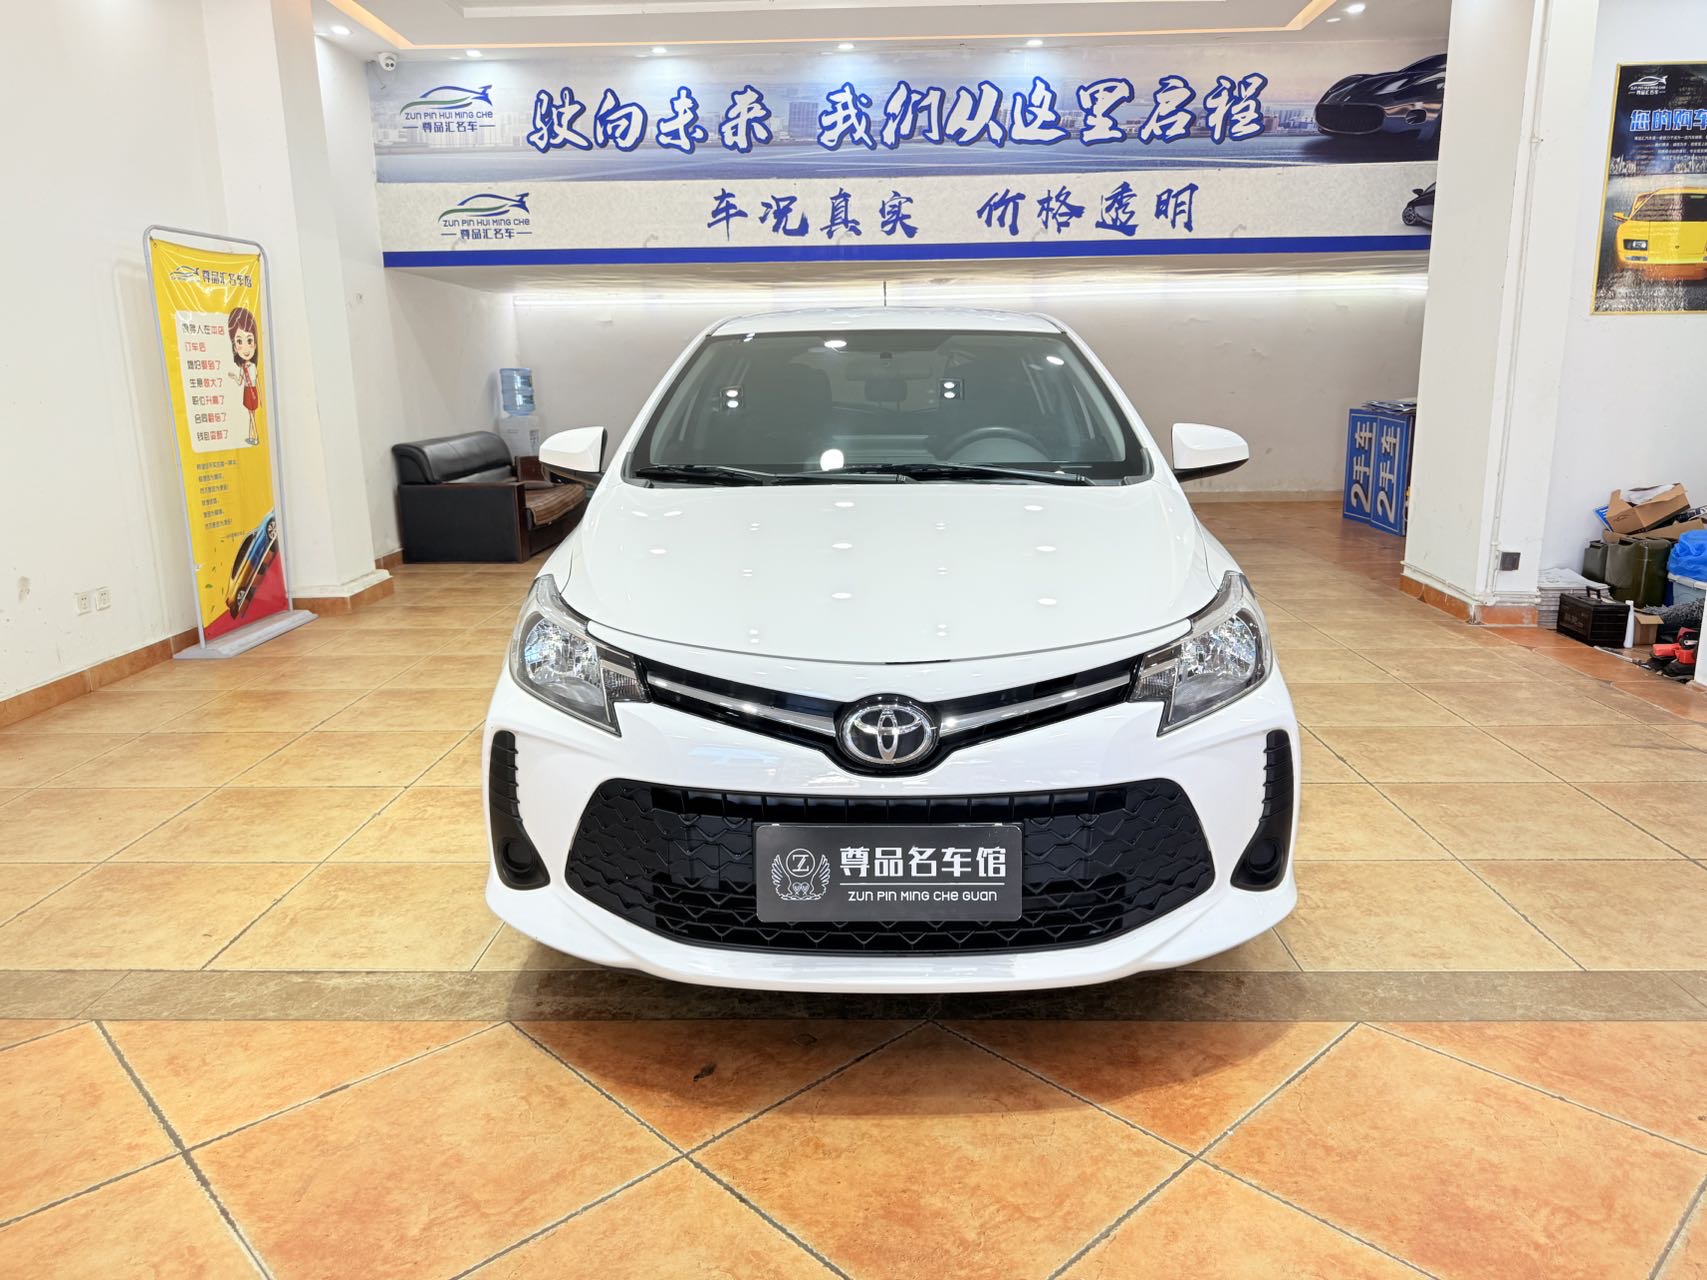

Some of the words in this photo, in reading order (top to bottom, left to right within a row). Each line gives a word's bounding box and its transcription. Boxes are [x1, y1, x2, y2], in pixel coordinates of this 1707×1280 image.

[528, 84, 772, 153] 驶向未来
[817, 72, 1268, 150] 我们从这里启程
[422, 121, 478, 133] 尊品汇名车
[707, 186, 918, 241] 车况真实
[977, 180, 1198, 236] 价格透明
[460, 228, 515, 240] 尊品汇名车
[840, 846, 1006, 878] 尊品名车馆
[901, 891, 929, 901] MING
